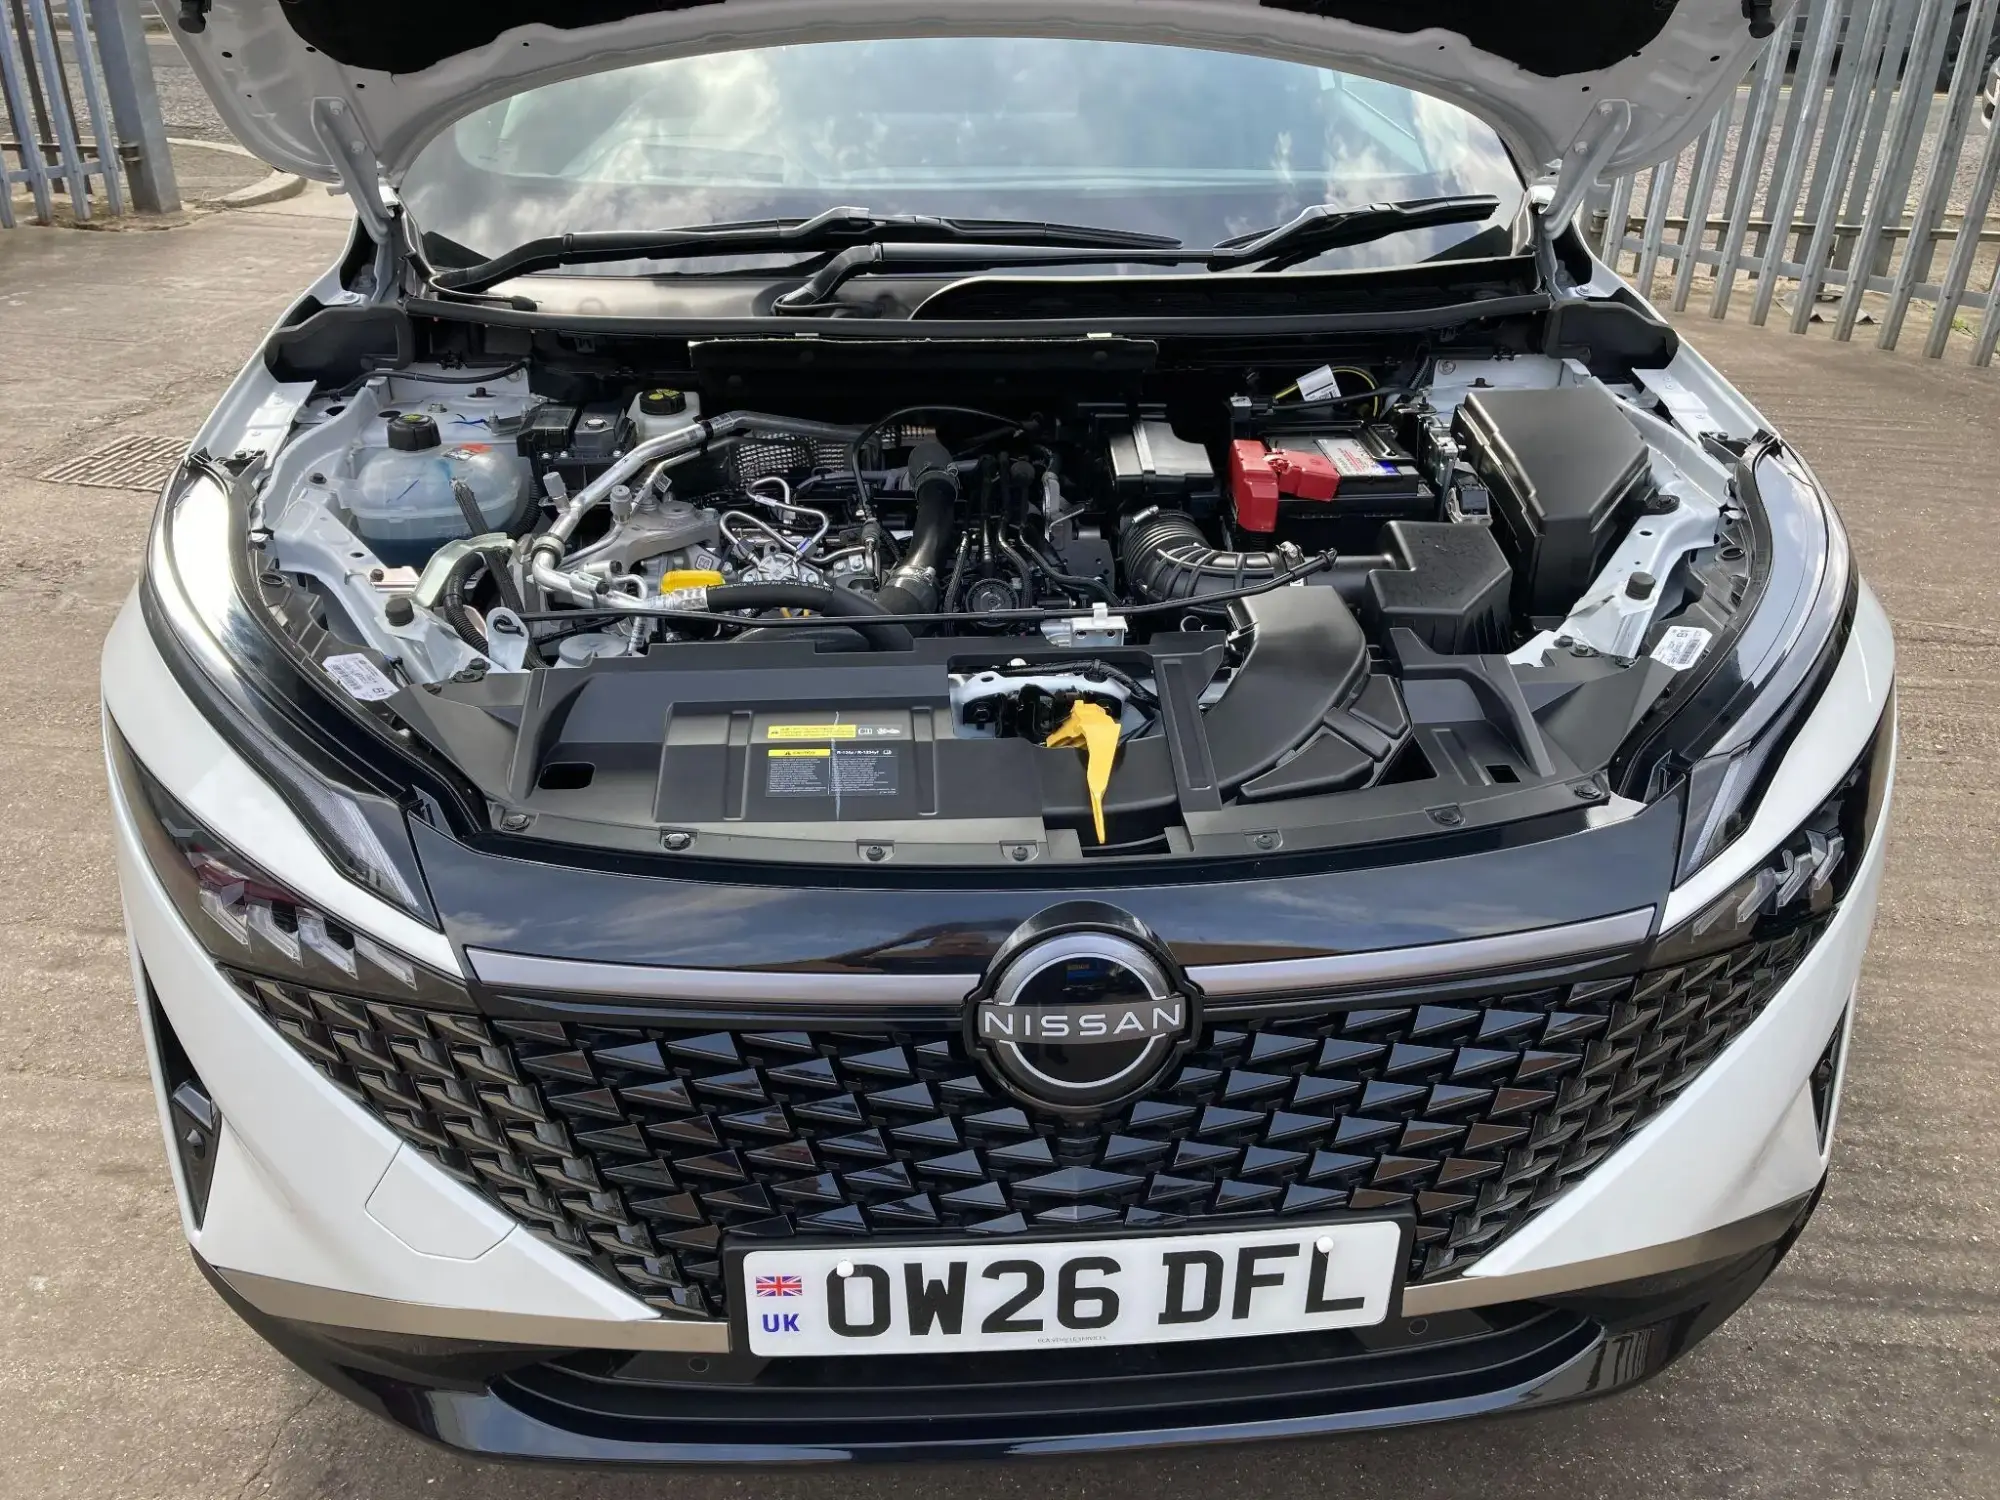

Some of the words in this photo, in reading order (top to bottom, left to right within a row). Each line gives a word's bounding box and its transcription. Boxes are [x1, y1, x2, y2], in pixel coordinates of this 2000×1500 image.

[984, 1003, 1181, 1037] NISSAN
[826, 1256, 1121, 1338] OW26
[1158, 1242, 1365, 1325] DFL
[762, 1313, 800, 1333] UK
